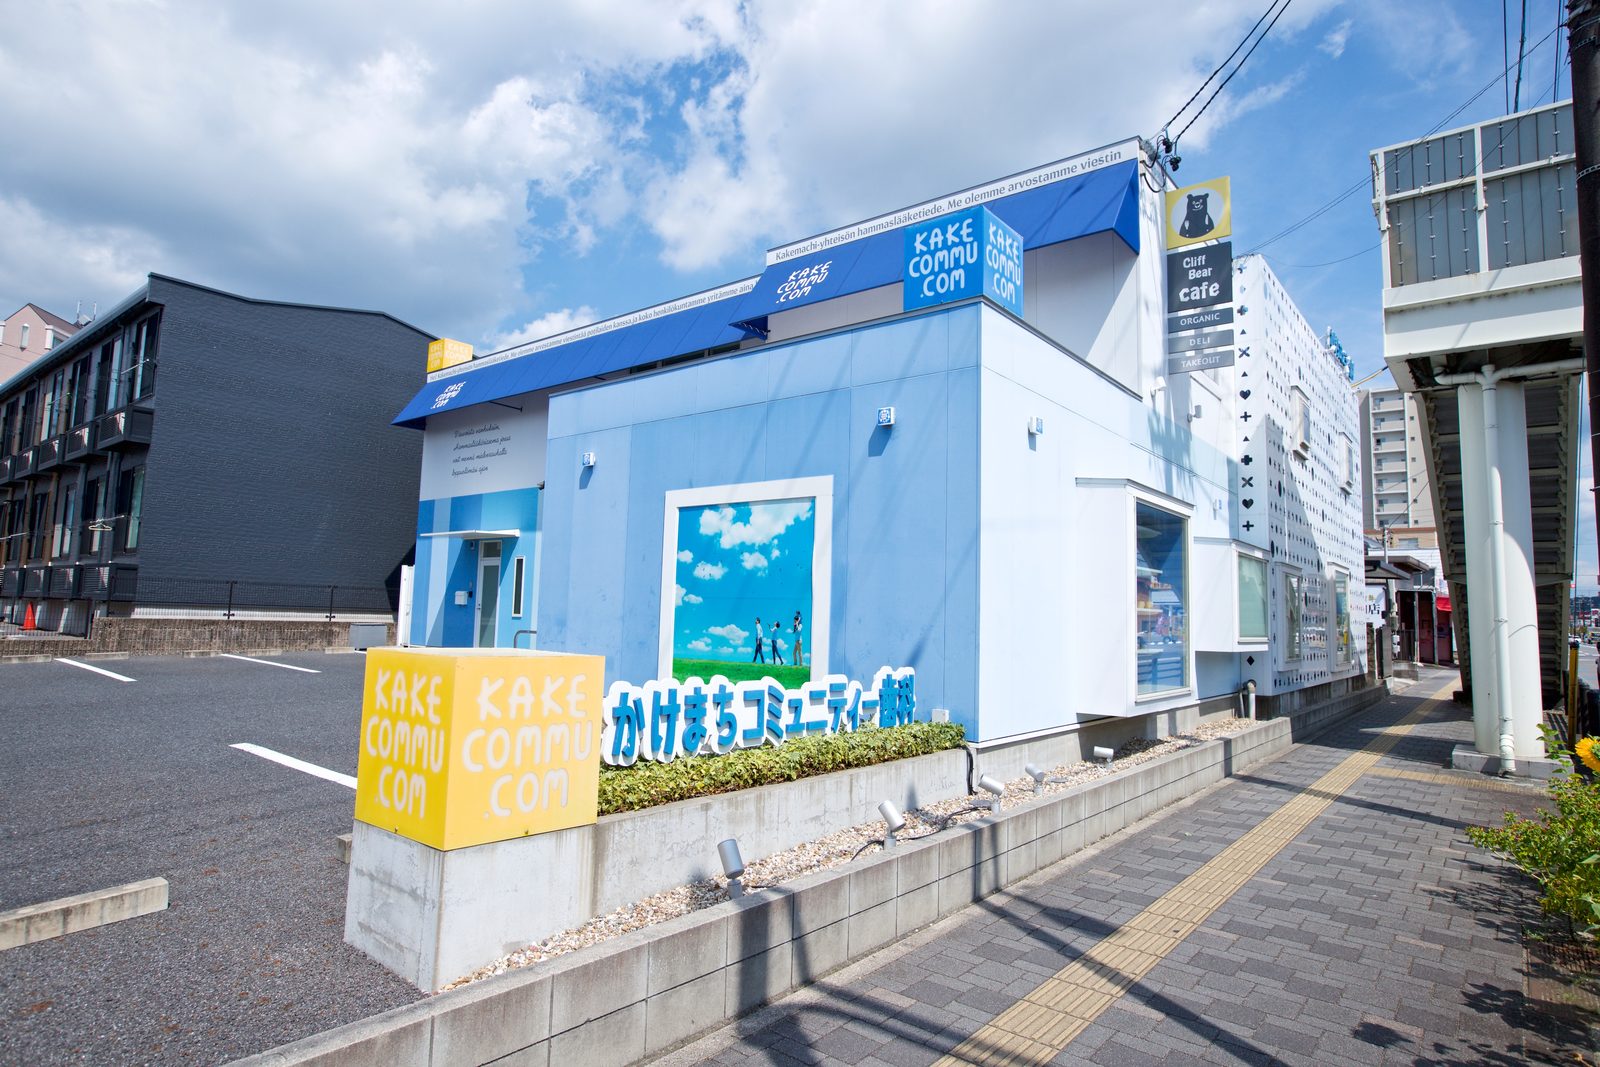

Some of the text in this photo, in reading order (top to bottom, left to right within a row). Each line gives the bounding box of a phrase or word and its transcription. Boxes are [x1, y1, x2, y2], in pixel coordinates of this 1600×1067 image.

[776, 151, 1122, 260] Kakemachi-yhteisön hammaslääketiede. Me olemme arvostamme viestin
[914, 218, 974, 254] KAKE
[989, 222, 1019, 265] KAKE
[788, 260, 832, 282] KAKE
[908, 241, 978, 278] COMMU
[986, 244, 1020, 286] COMMU
[1183, 254, 1206, 269] Cliff
[1189, 268, 1212, 280] Bear
[776, 286, 812, 304] .COM
[777, 272, 828, 293] COMMU
[920, 268, 964, 298] .COM
[1179, 282, 1220, 302] cafe
[638, 312, 652, 322] koko
[653, 296, 706, 317] henkilökuntamme
[707, 288, 738, 304] yritämme
[739, 282, 754, 293] aina
[1180, 312, 1220, 326] ORGANIC
[1190, 336, 1210, 346] DELI
[1181, 356, 1221, 368] TAKEOUT
[375, 667, 442, 724] KAKE
[477, 673, 586, 721] KAKE
[612, 674, 916, 757] かけまちコミュニティー歯科
[366, 716, 444, 774] COMMU
[462, 720, 592, 773] COMMU
[484, 768, 568, 818] .COM
